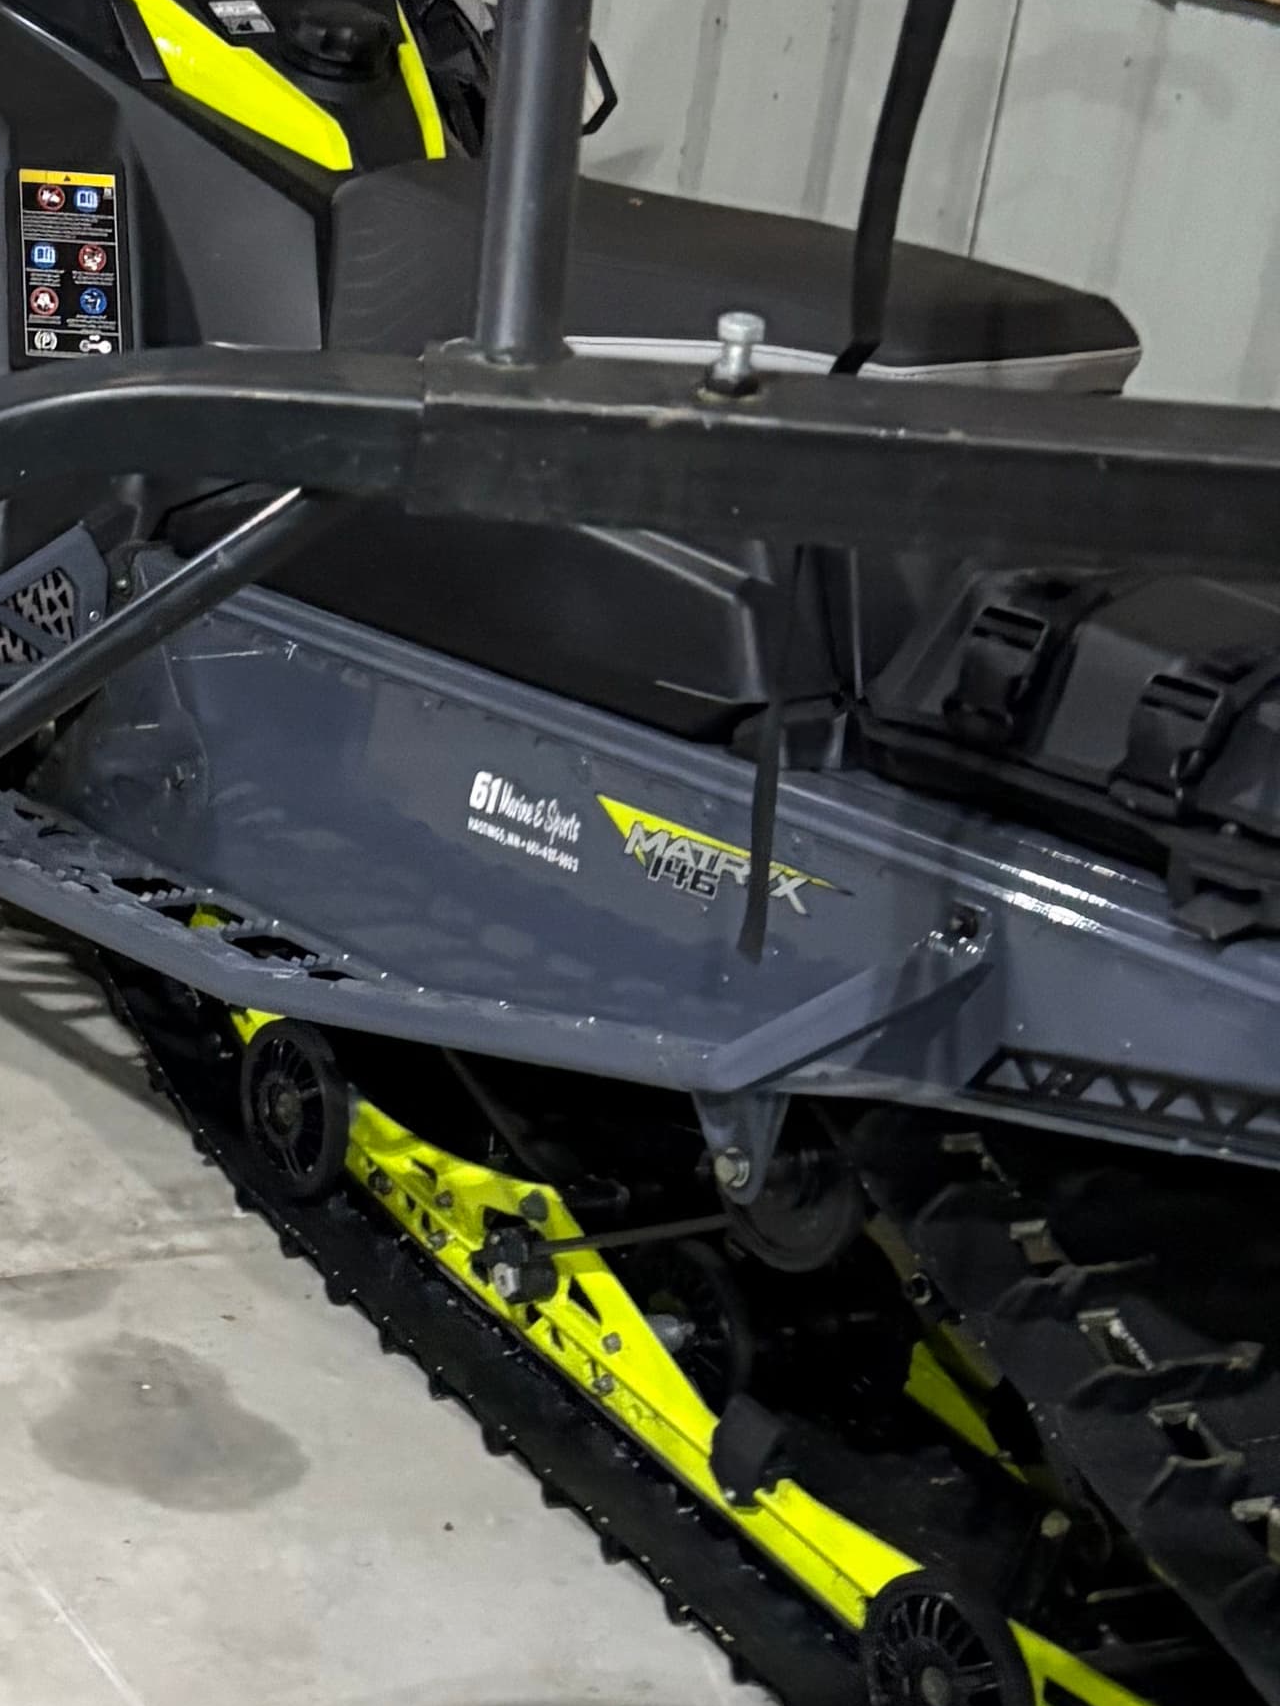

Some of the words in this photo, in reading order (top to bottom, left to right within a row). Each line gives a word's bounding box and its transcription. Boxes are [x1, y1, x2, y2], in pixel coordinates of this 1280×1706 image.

[469, 770, 503, 815] 61
[623, 820, 810, 916] MATRX
[647, 854, 722, 900] 146
